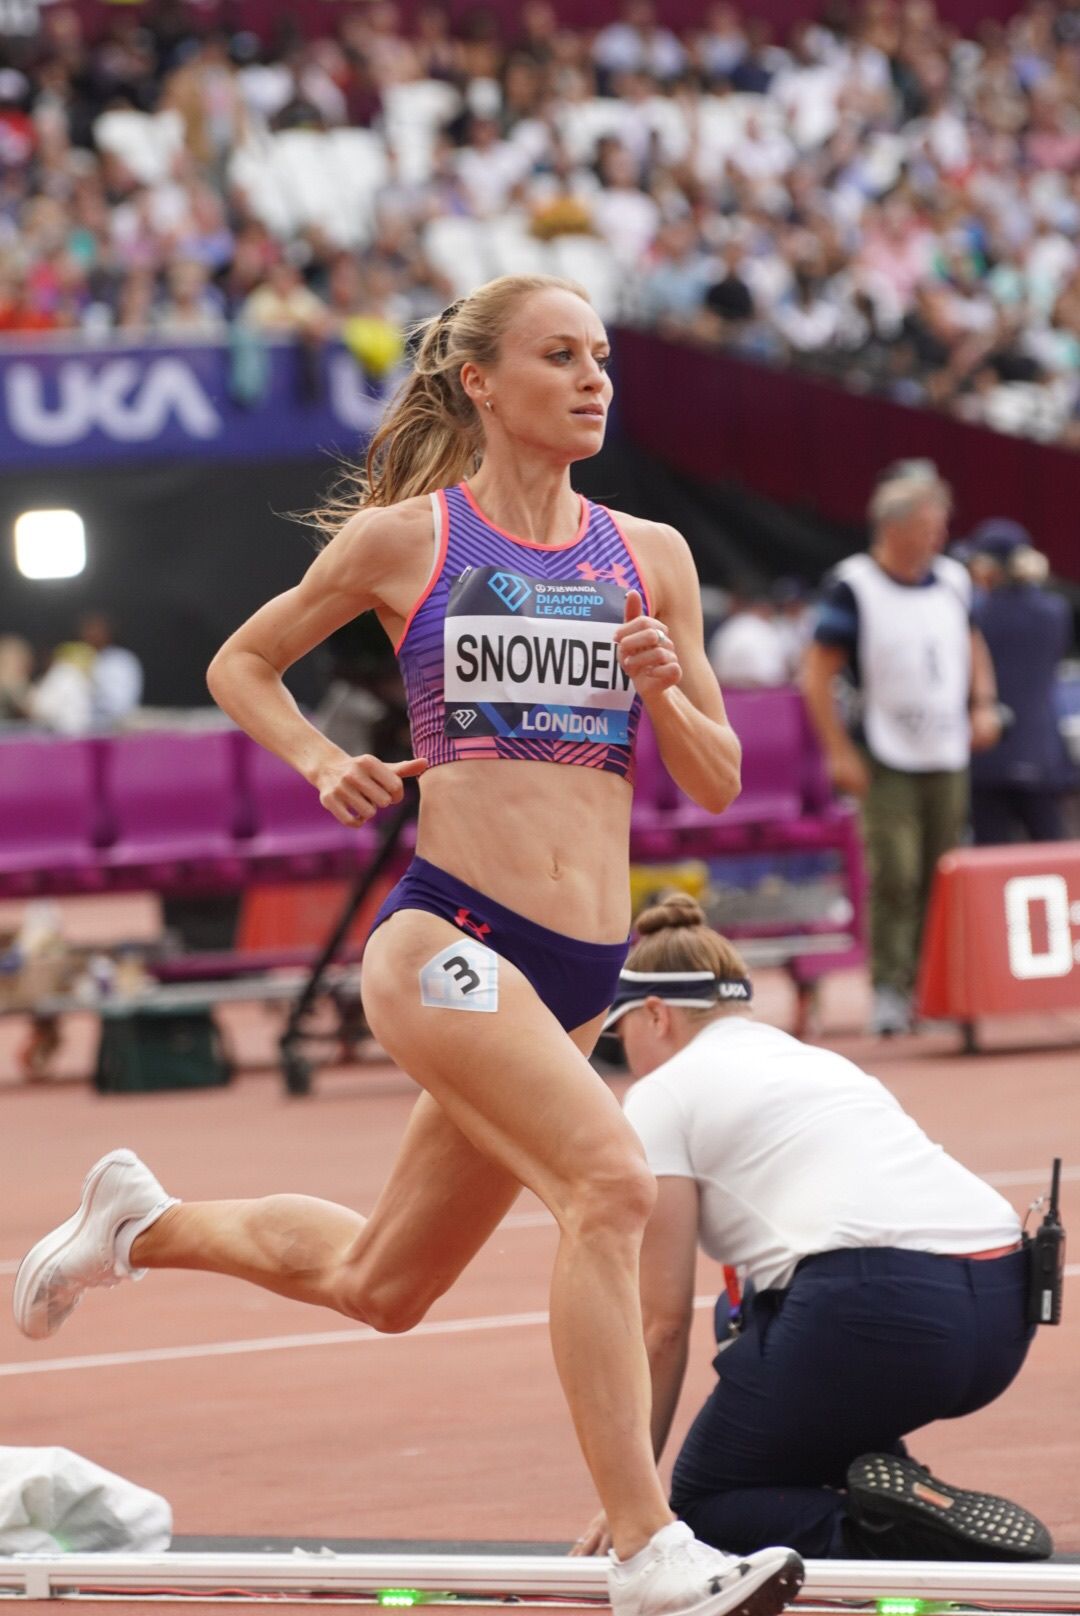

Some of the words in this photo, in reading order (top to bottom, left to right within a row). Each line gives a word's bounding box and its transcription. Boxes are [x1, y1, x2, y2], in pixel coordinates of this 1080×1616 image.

[5, 357, 223, 447] UKA
[536, 594, 604, 606] DIAMOND
[536, 605, 592, 617] LEAGUE
[522, 711, 608, 736] LONDON
[442, 955, 481, 995] 3
